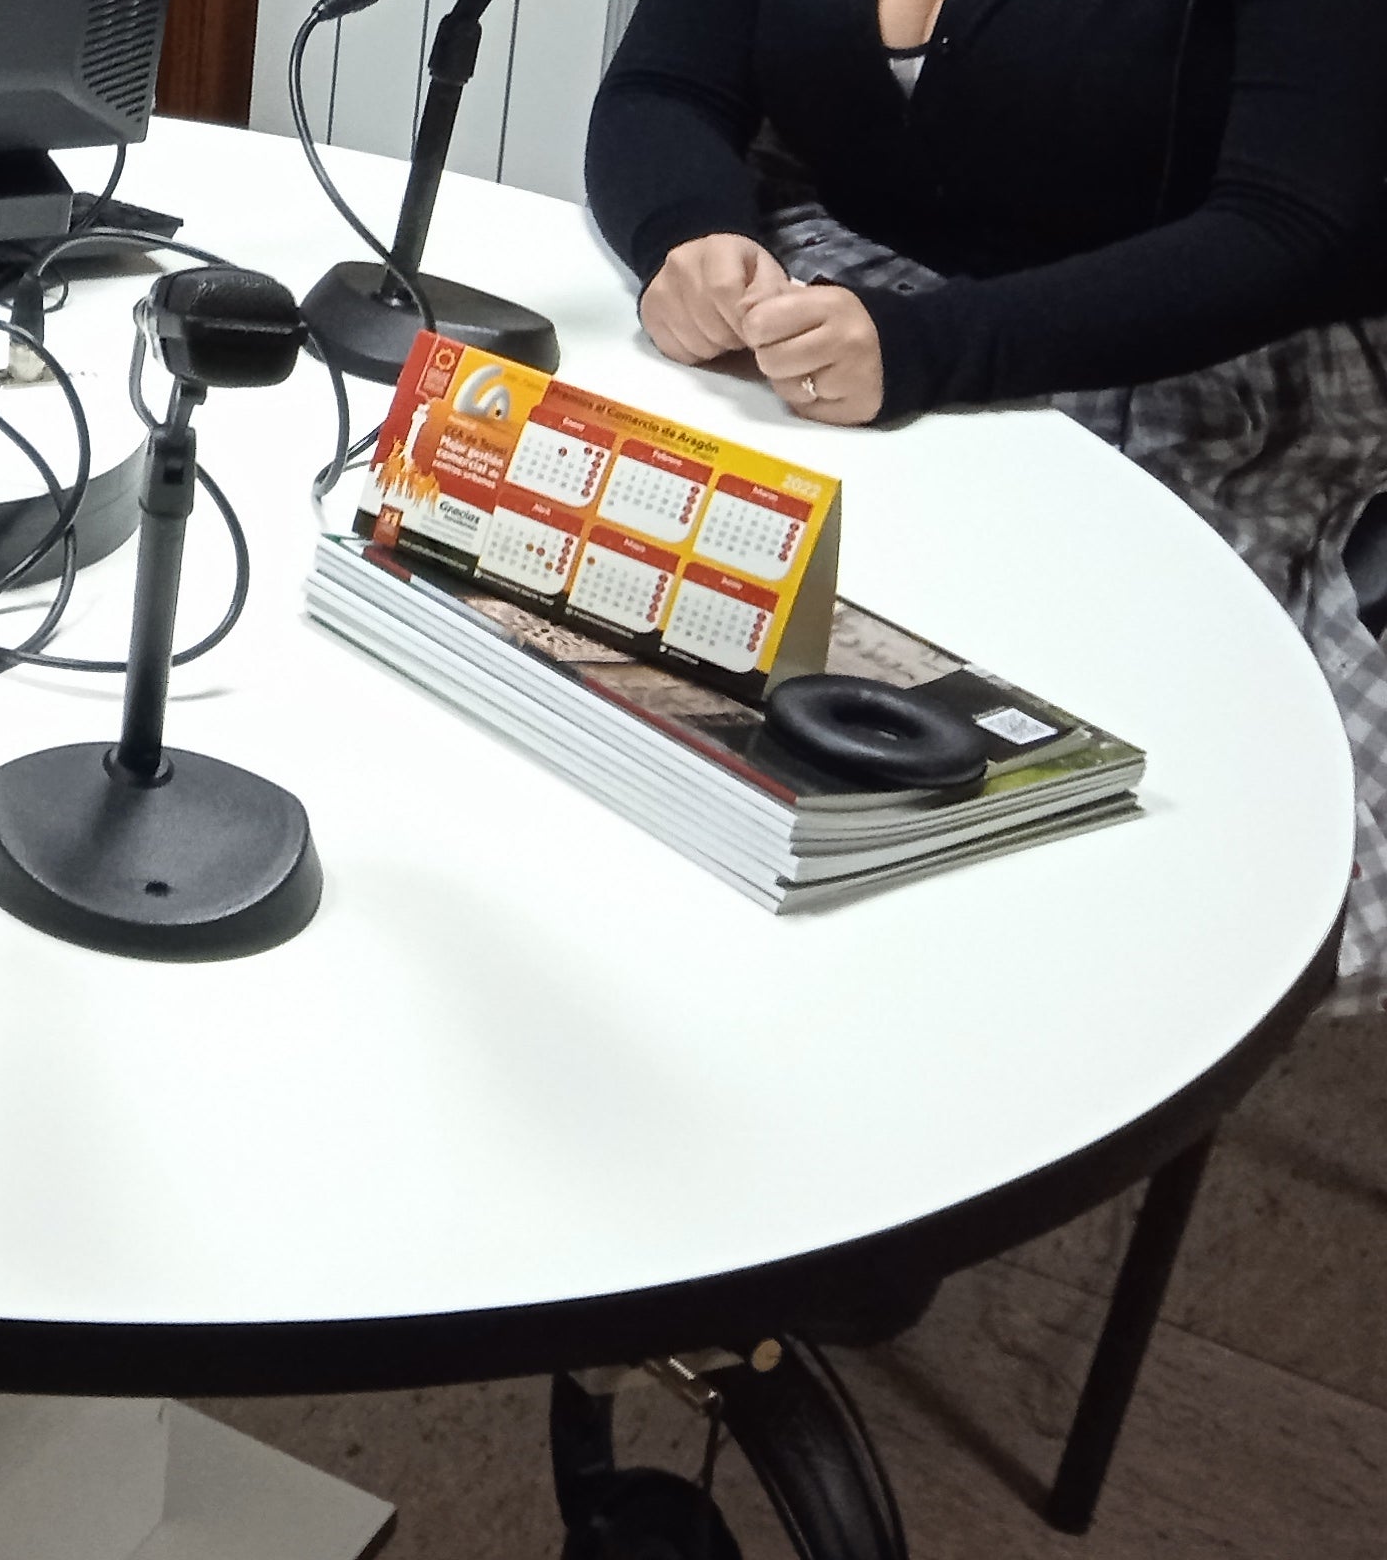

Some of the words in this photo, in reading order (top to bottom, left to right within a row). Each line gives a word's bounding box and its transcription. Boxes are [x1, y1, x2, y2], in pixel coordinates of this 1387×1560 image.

[608, 405, 660, 432] Comercio
[662, 425, 676, 439] de
[678, 430, 720, 455] Aragón
[440, 500, 480, 525] Gracias
